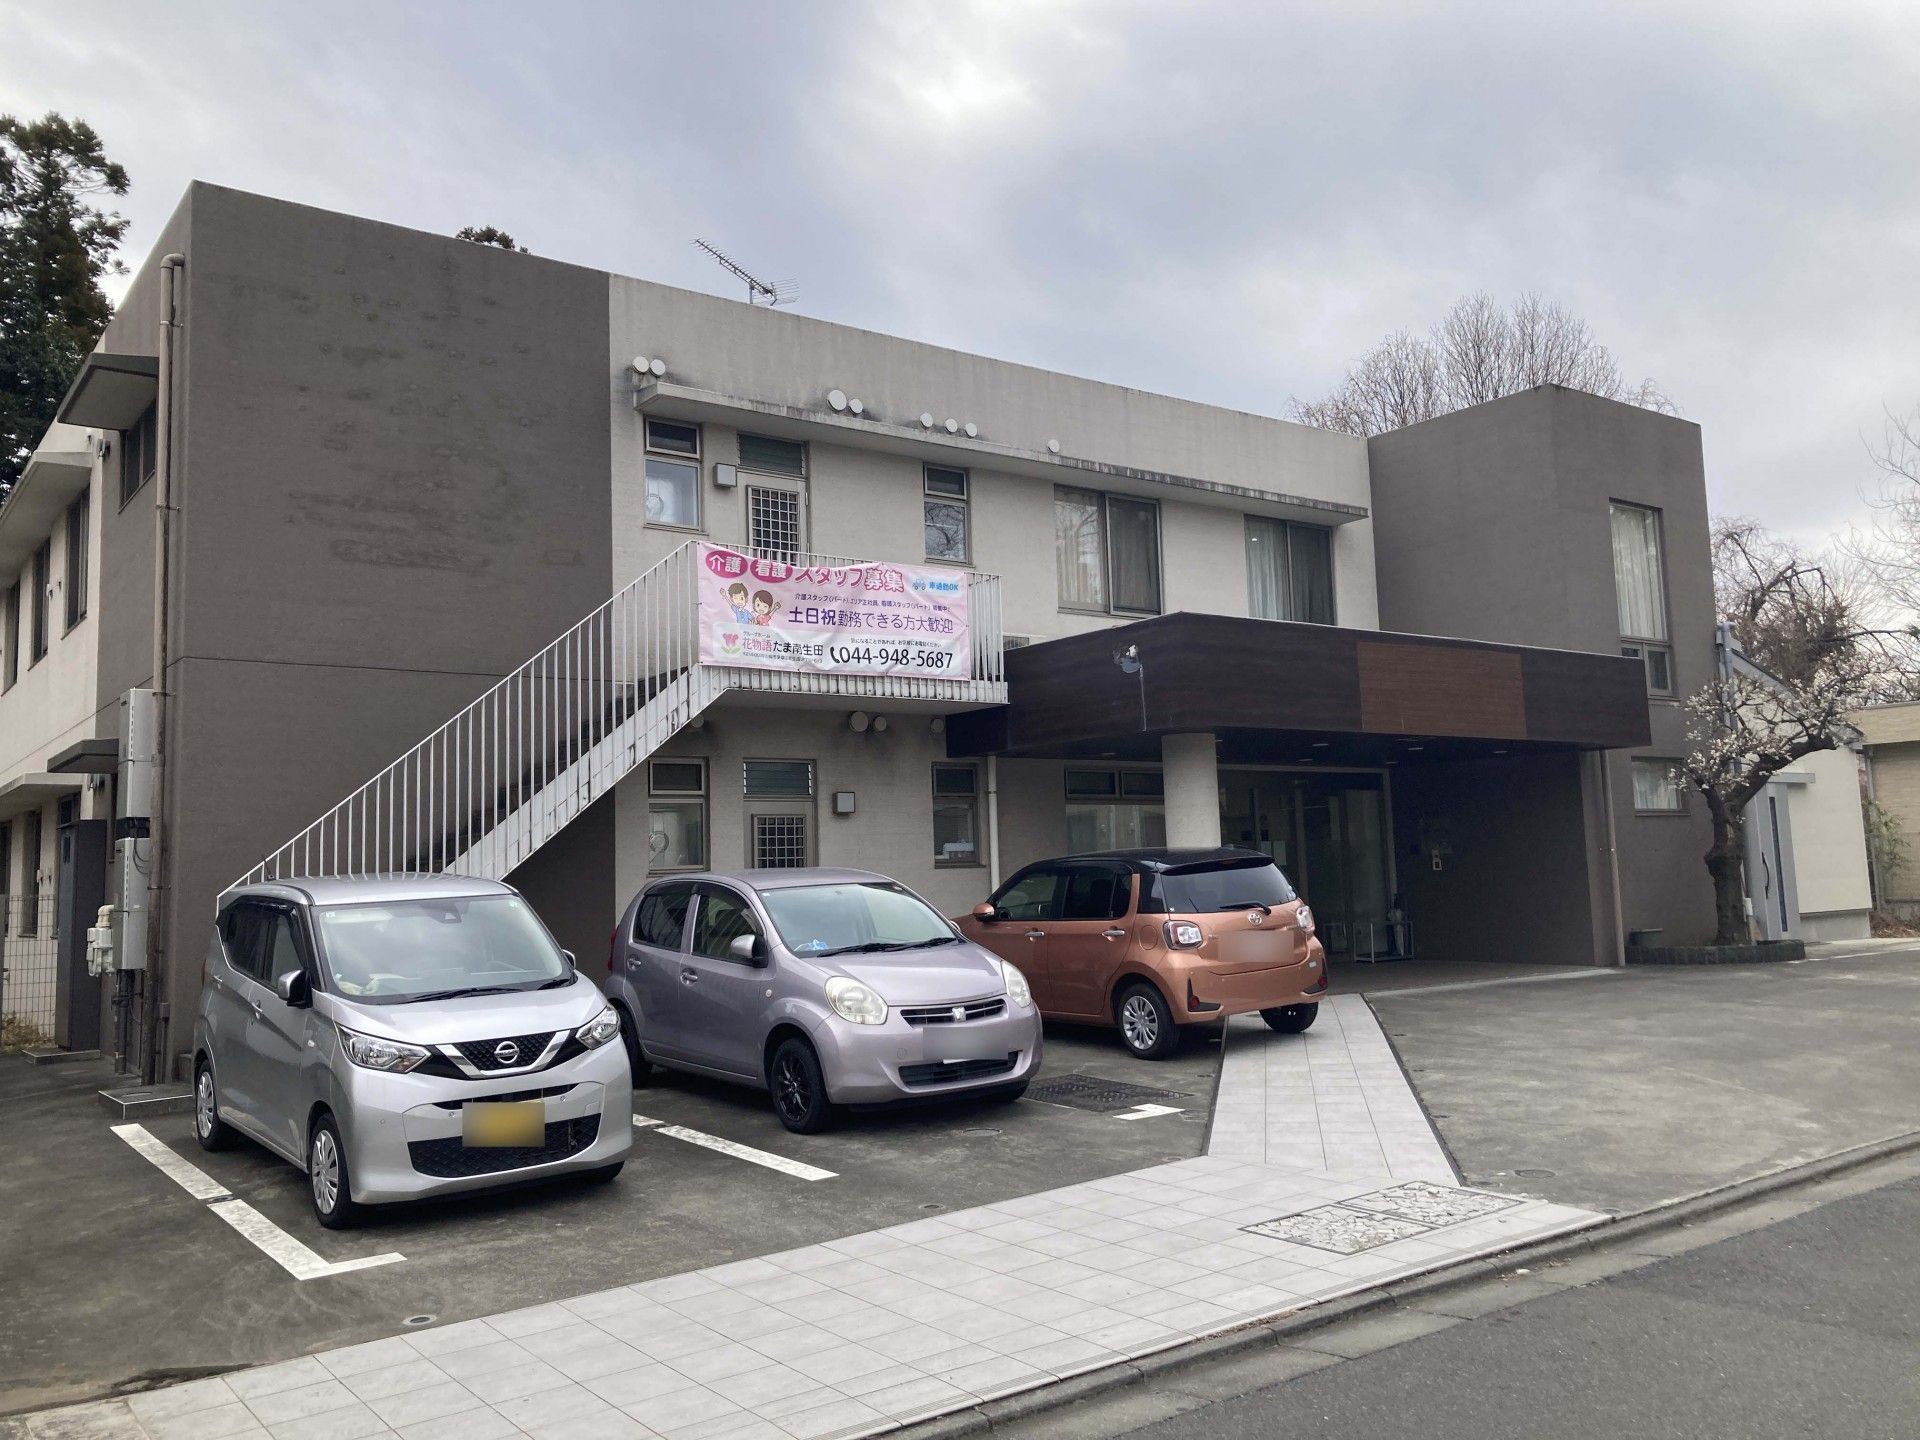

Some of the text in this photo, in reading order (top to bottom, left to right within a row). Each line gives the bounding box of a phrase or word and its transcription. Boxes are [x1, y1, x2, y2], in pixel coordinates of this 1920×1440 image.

[709, 554, 905, 592] 介護 看護 スタッフ募集
[788, 606, 954, 634] 土日祝勤務できる方大歓迎
[743, 637, 824, 656] 花物語たま南生田
[839, 646, 953, 669] 044-948-5687
